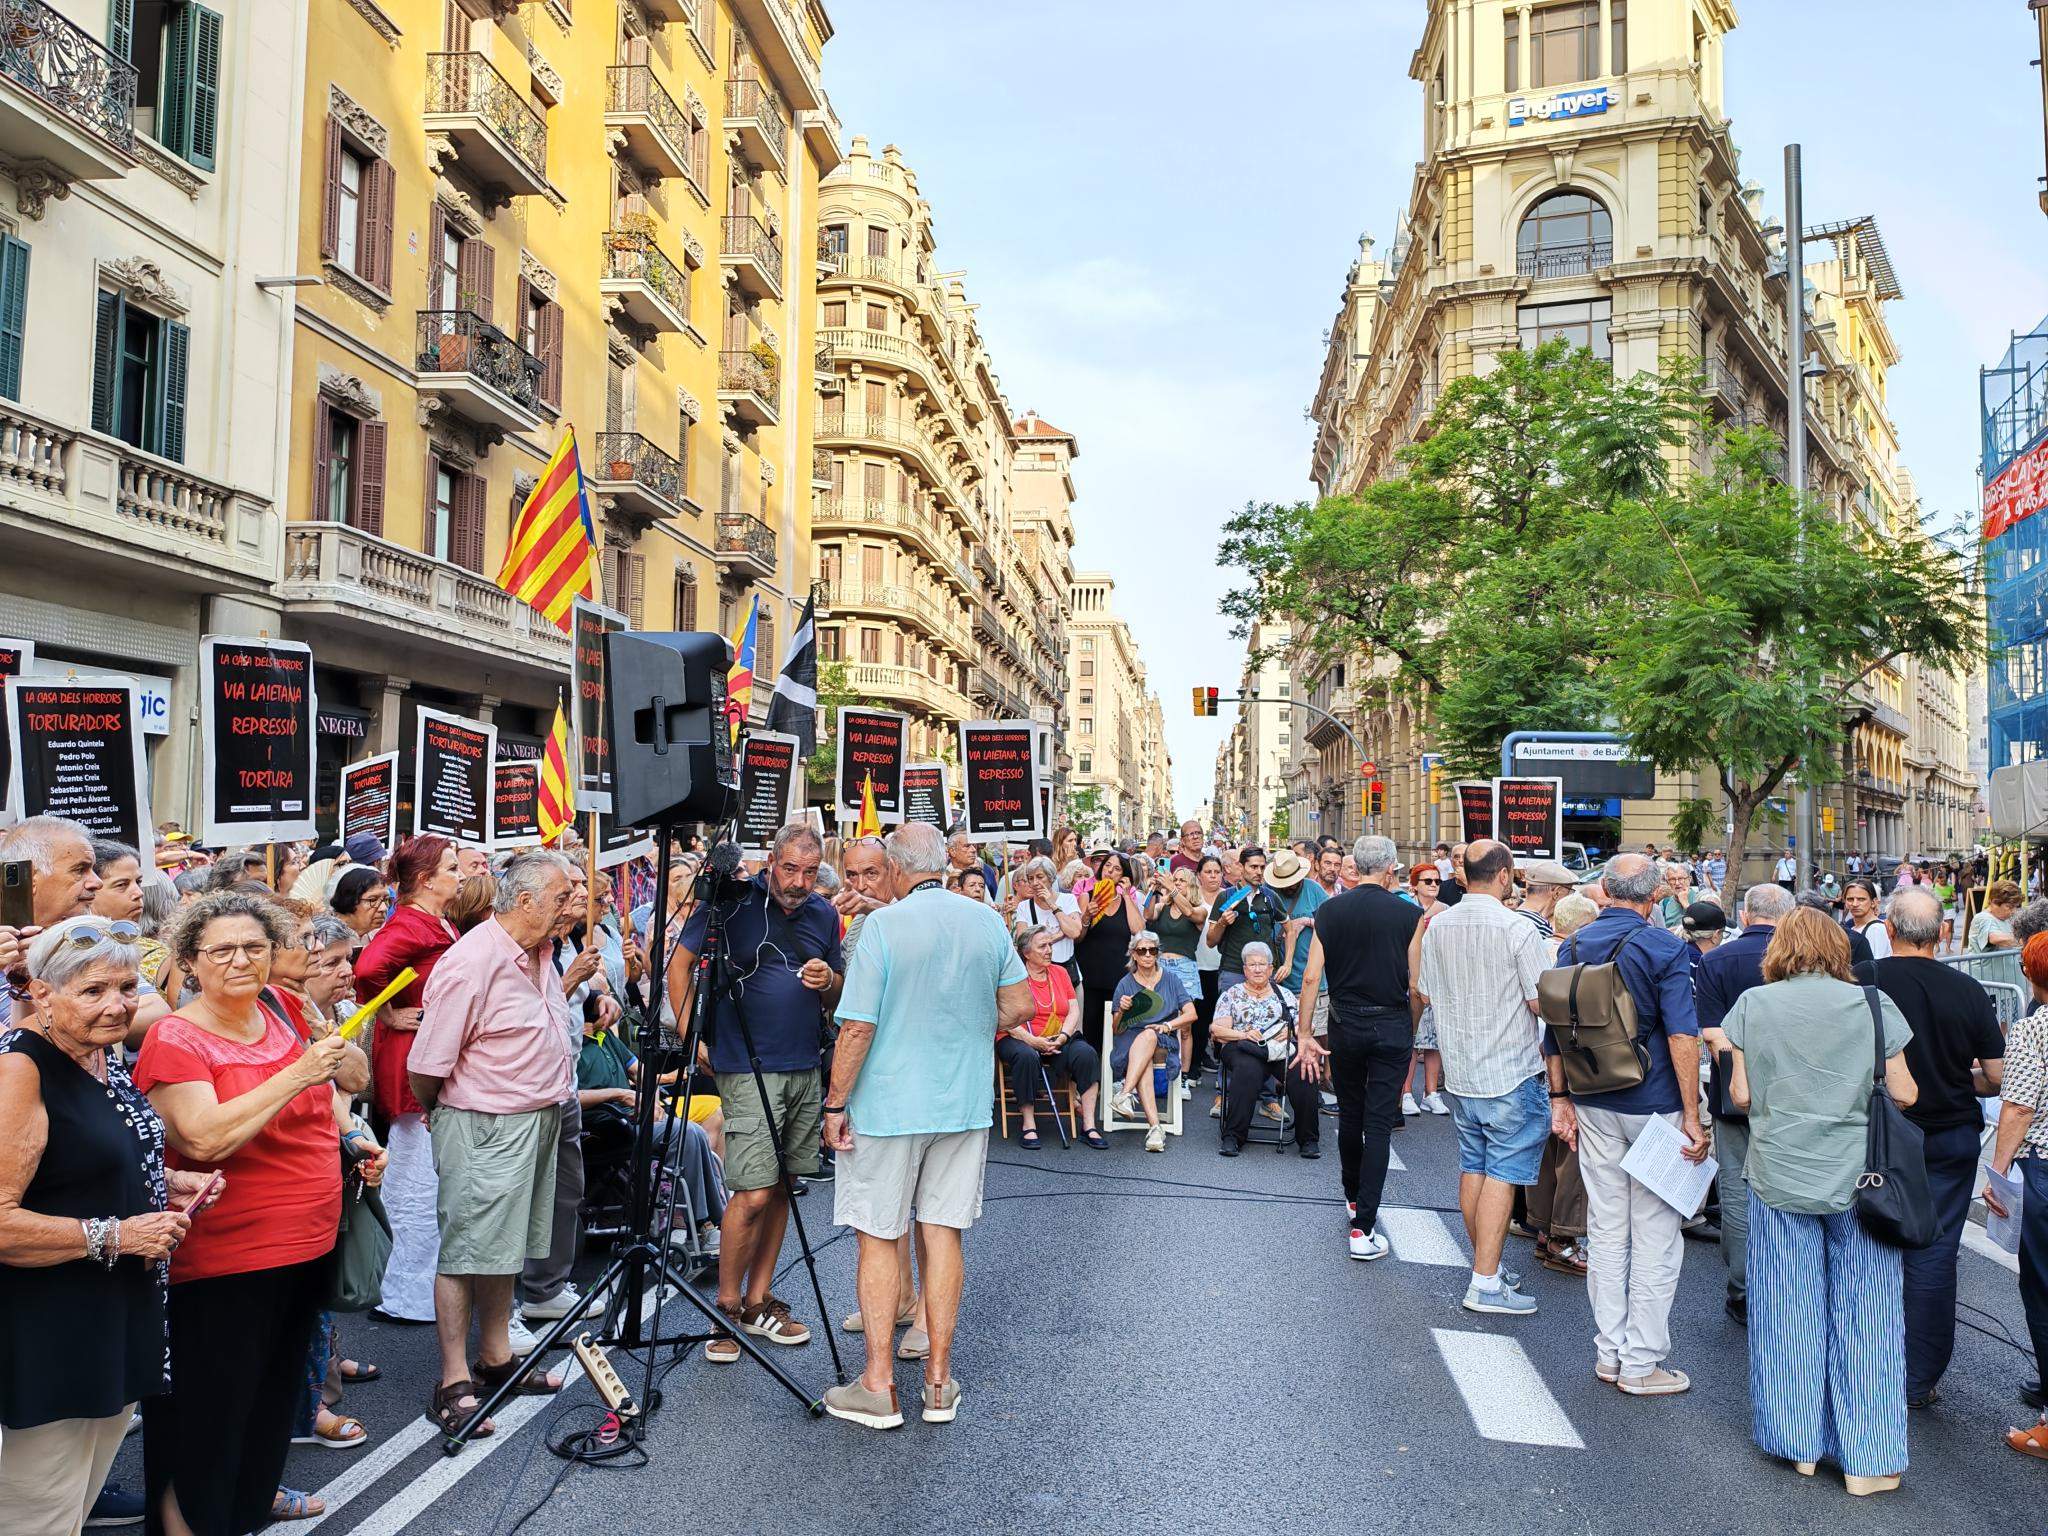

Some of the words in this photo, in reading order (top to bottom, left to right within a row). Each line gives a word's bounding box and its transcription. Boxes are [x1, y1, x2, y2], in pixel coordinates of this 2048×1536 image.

[1509, 91, 1620, 119] Enginyers
[220, 653, 229, 665] LA
[232, 655, 252, 666] CASA
[254, 656, 272, 667] DELS
[274, 658, 303, 671] HORRORS
[25, 691, 35, 703] LA
[37, 691, 57, 703] CASA
[60, 692, 80, 704] DELS
[83, 692, 122, 704] HORRORS
[224, 681, 245, 700] VIA
[251, 683, 301, 703] LAIETANA
[27, 713, 121, 731] TORTURADORS
[232, 715, 297, 735] REPRESSIÓ
[319, 716, 364, 737] NEGRA
[78, 740, 104, 748] Quintela
[849, 731, 862, 743] VIA
[865, 733, 897, 747] LAIETANA
[429, 734, 482, 758] TORTURADORS
[496, 743, 511, 757] OSA
[513, 744, 542, 759] NEGRA
[1523, 747, 1574, 757] Ajuntament
[1593, 747, 1604, 756] de
[59, 753, 80, 761] Pedro
[853, 751, 893, 764] REPRESSIÓ
[969, 750, 980, 760] VIA
[983, 749, 1019, 761] LAIETANA,
[56, 764, 82, 772] Antonio
[747, 755, 789, 769] TORTURADORS
[57, 775, 83, 783] Vicente
[239, 769, 293, 788] TORTURA
[979, 766, 1024, 780] REPRESSIÓ
[856, 781, 889, 794] TOTURA
[904, 778, 938, 786] ORTURADORS
[84, 785, 108, 793] Trapote
[49, 797, 68, 805] David
[69, 796, 87, 804] Peña
[984, 800, 1021, 811] TORTURA
[1504, 796, 1516, 805] VIA
[1518, 796, 1552, 806] LAIETANA
[43, 809, 70, 817] Genuino
[72, 807, 97, 815] Navales
[1507, 810, 1547, 820] REPRESSIÓ
[501, 815, 530, 824] TORTURA
[1510, 834, 1543, 845] TORTURA
